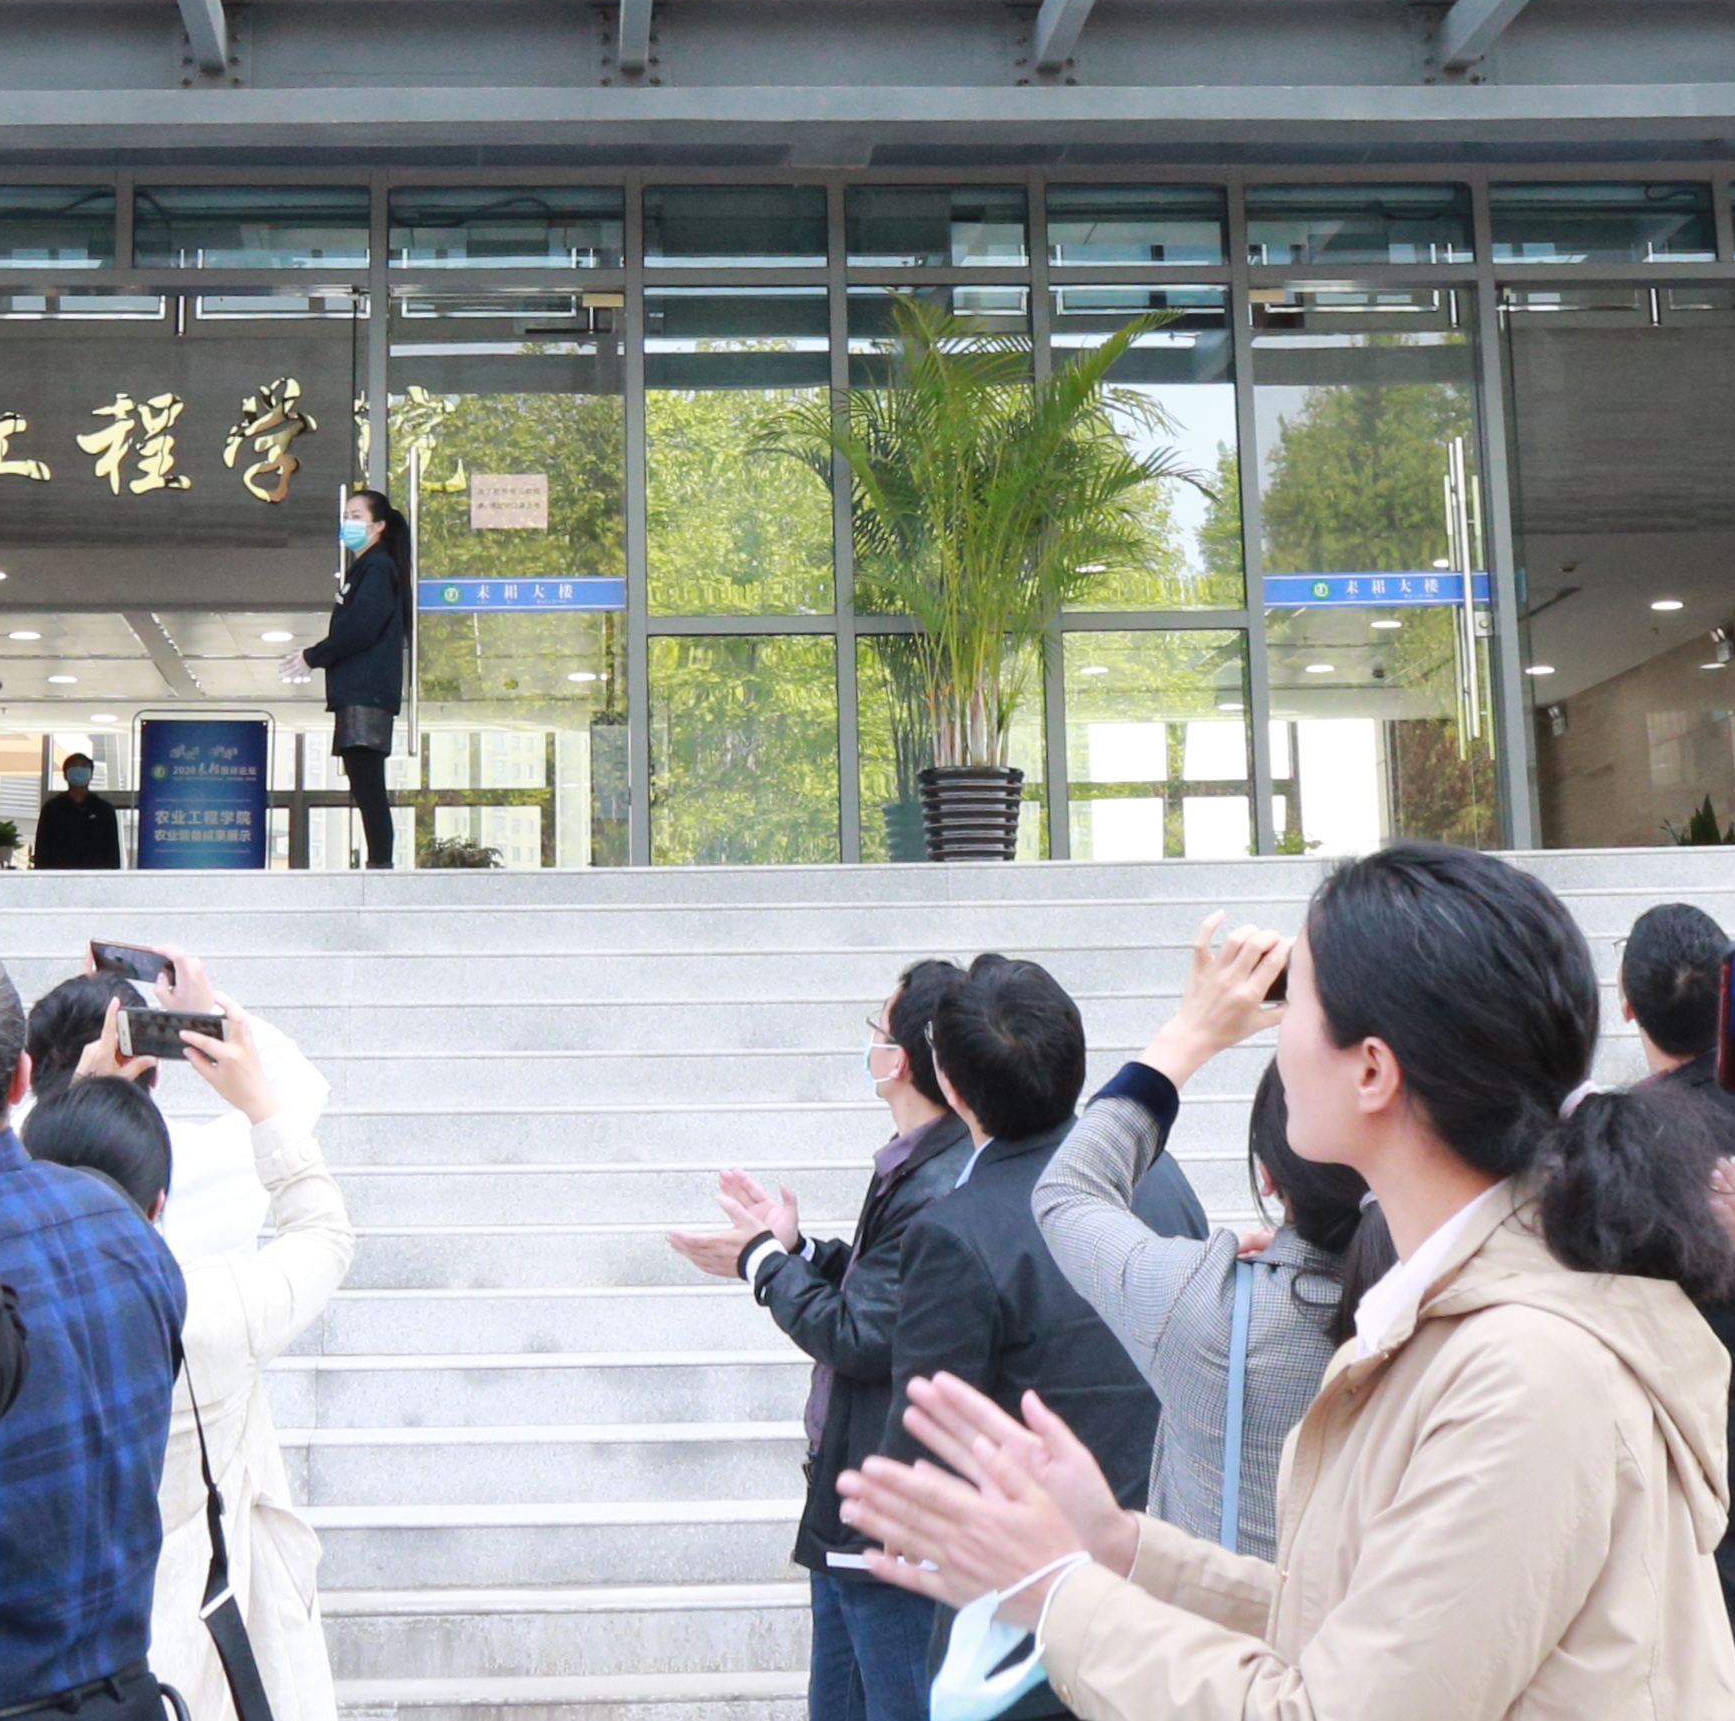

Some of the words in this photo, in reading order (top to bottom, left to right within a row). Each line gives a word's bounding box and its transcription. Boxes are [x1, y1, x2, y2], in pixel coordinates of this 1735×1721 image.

[154, 809, 252, 826] 农业工程学院
